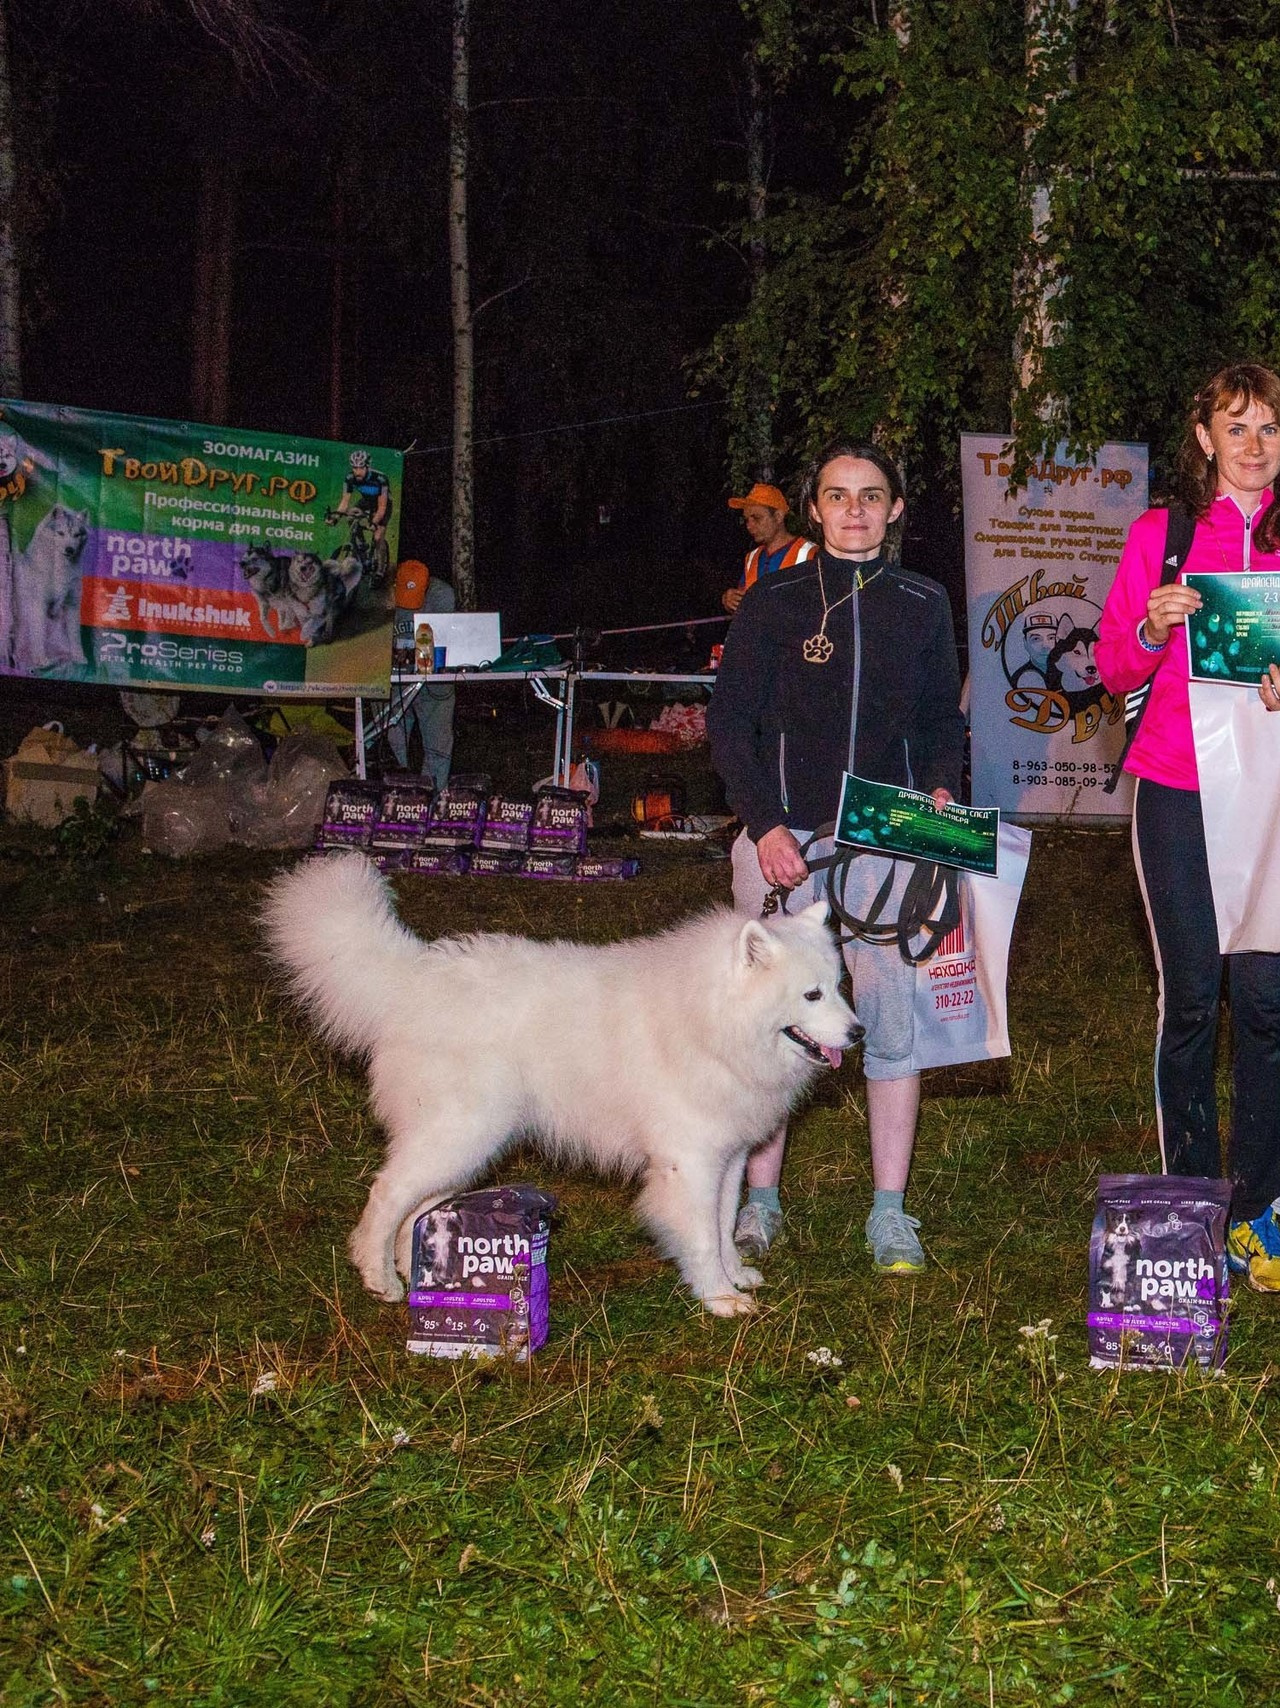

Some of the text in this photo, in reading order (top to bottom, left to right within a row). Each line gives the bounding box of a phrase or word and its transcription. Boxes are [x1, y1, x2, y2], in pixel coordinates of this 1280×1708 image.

[202, 440, 320, 467] ЗООМАГАЗИН
[144, 491, 315, 524] Профессиональные
[1059, 509, 1095, 522] корма
[171, 515, 314, 542] корма для собак
[1039, 522, 1061, 532] для
[1066, 524, 1124, 536] животных
[107, 534, 192, 558] north
[1050, 536, 1092, 549] ручной
[1021, 547, 1075, 561] Ездового
[1079, 551, 1120, 564] Спорта
[111, 554, 172, 577] paw
[1241, 577, 1280, 589] ДРАЙЛЕНД
[1264, 592, 1279, 603] 2-3
[138, 598, 251, 627] Inukshuk
[140, 658, 182, 669] HEALTH
[188, 662, 207, 670] PET
[212, 663, 243, 674] FOOD
[341, 803, 373, 813] north
[396, 803, 427, 813] north
[448, 800, 478, 811] north
[500, 801, 532, 812] north
[343, 811, 366, 821] paw
[397, 811, 420, 820] paw
[450, 808, 470, 818] paw
[501, 809, 525, 819] paw
[551, 807, 582, 818] north
[919, 803, 969, 825] 2-3 СЕНТЯБРЯ
[552, 815, 575, 825] paw
[478, 858, 499, 866] north
[532, 860, 553, 868] north
[583, 863, 603, 871] north
[928, 960, 977, 980] НАХОДКА
[935, 990, 974, 1009] 310-22-22
[457, 1234, 529, 1255] north
[462, 1255, 514, 1278] paw
[1136, 1258, 1214, 1279] north
[1141, 1278, 1198, 1301] paw
